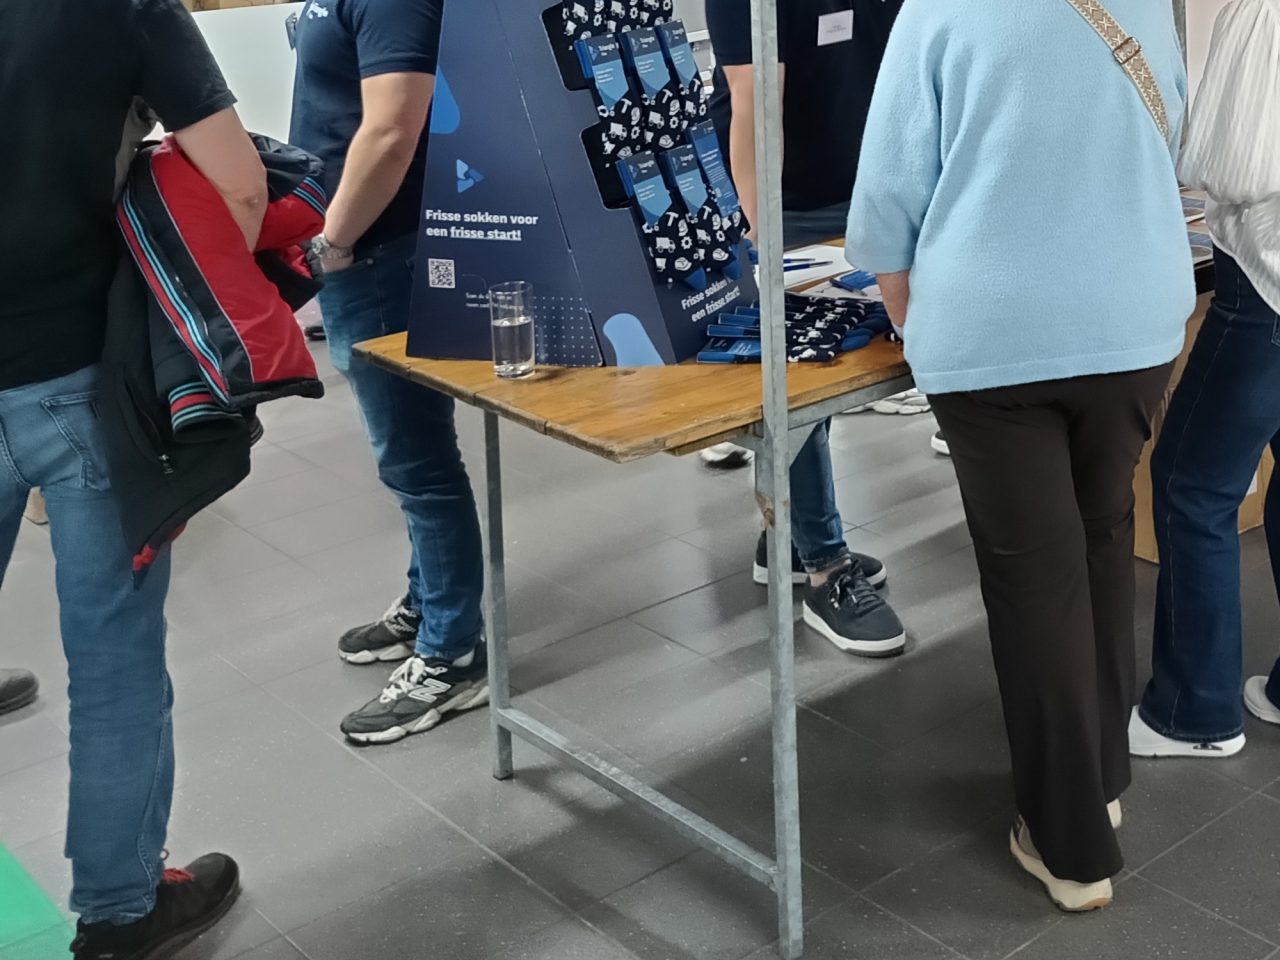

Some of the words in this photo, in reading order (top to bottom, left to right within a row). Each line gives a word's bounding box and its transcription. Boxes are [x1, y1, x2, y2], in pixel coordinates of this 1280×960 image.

[425, 209, 461, 222] Frisse
[463, 211, 507, 224] sokken
[510, 215, 539, 225] voor
[426, 227, 448, 237] een
[450, 226, 484, 239] frisse
[487, 229, 521, 240] start!
[681, 292, 704, 310] Frisse
[704, 279, 728, 297] sokken
[691, 309, 706, 322] een
[705, 298, 725, 315] frisse
